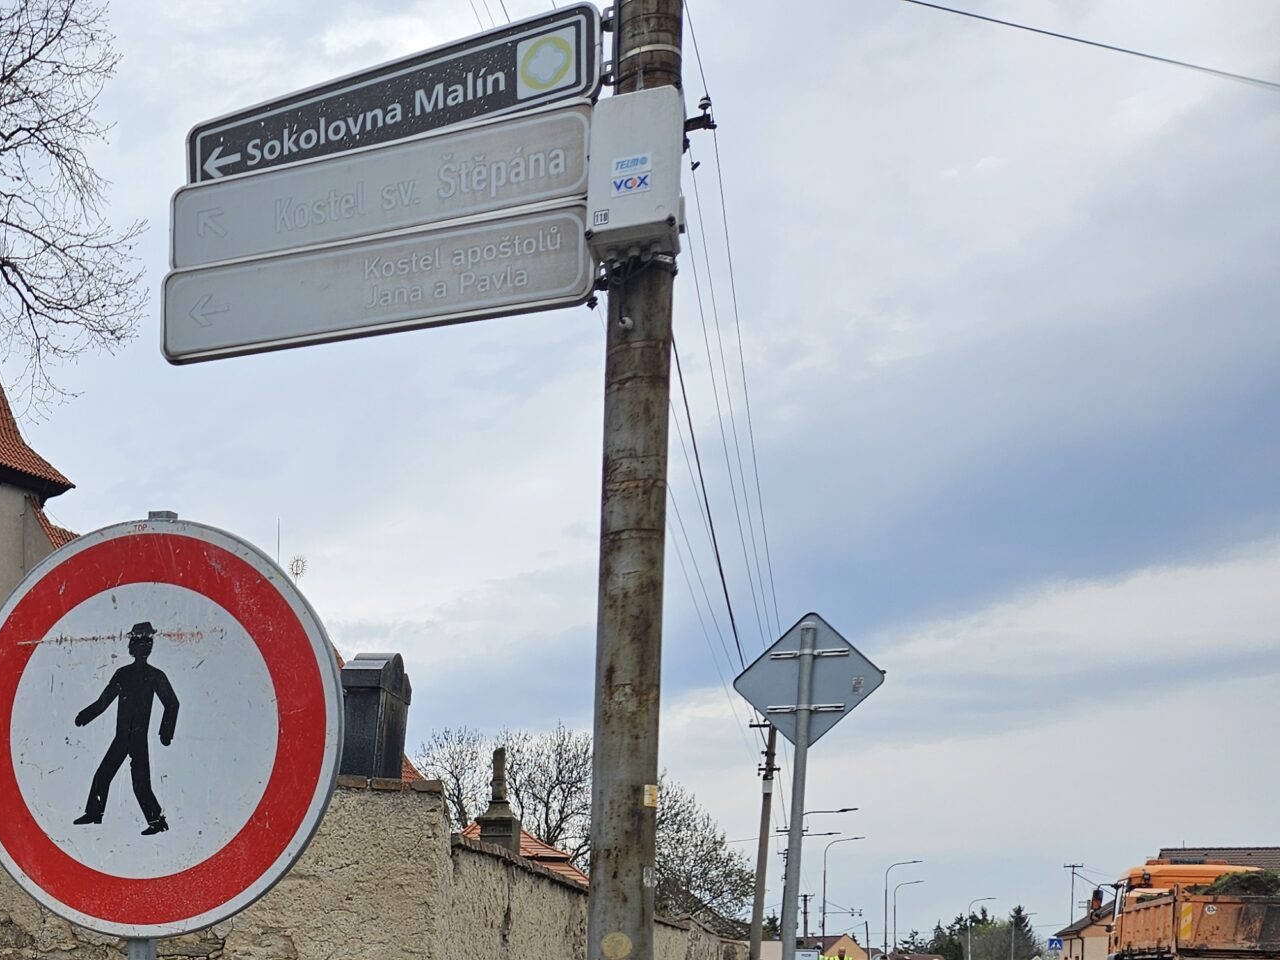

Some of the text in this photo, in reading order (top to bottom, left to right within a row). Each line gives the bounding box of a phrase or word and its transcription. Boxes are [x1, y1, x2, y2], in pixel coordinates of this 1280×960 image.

[246, 68, 506, 166] Sokolovna Malín
[275, 147, 567, 233] Kostel sv. Štěpána
[613, 175, 648, 191] VOX
[364, 225, 561, 280] Kostel apoštolů
[367, 266, 528, 309] Jana a Pavla
